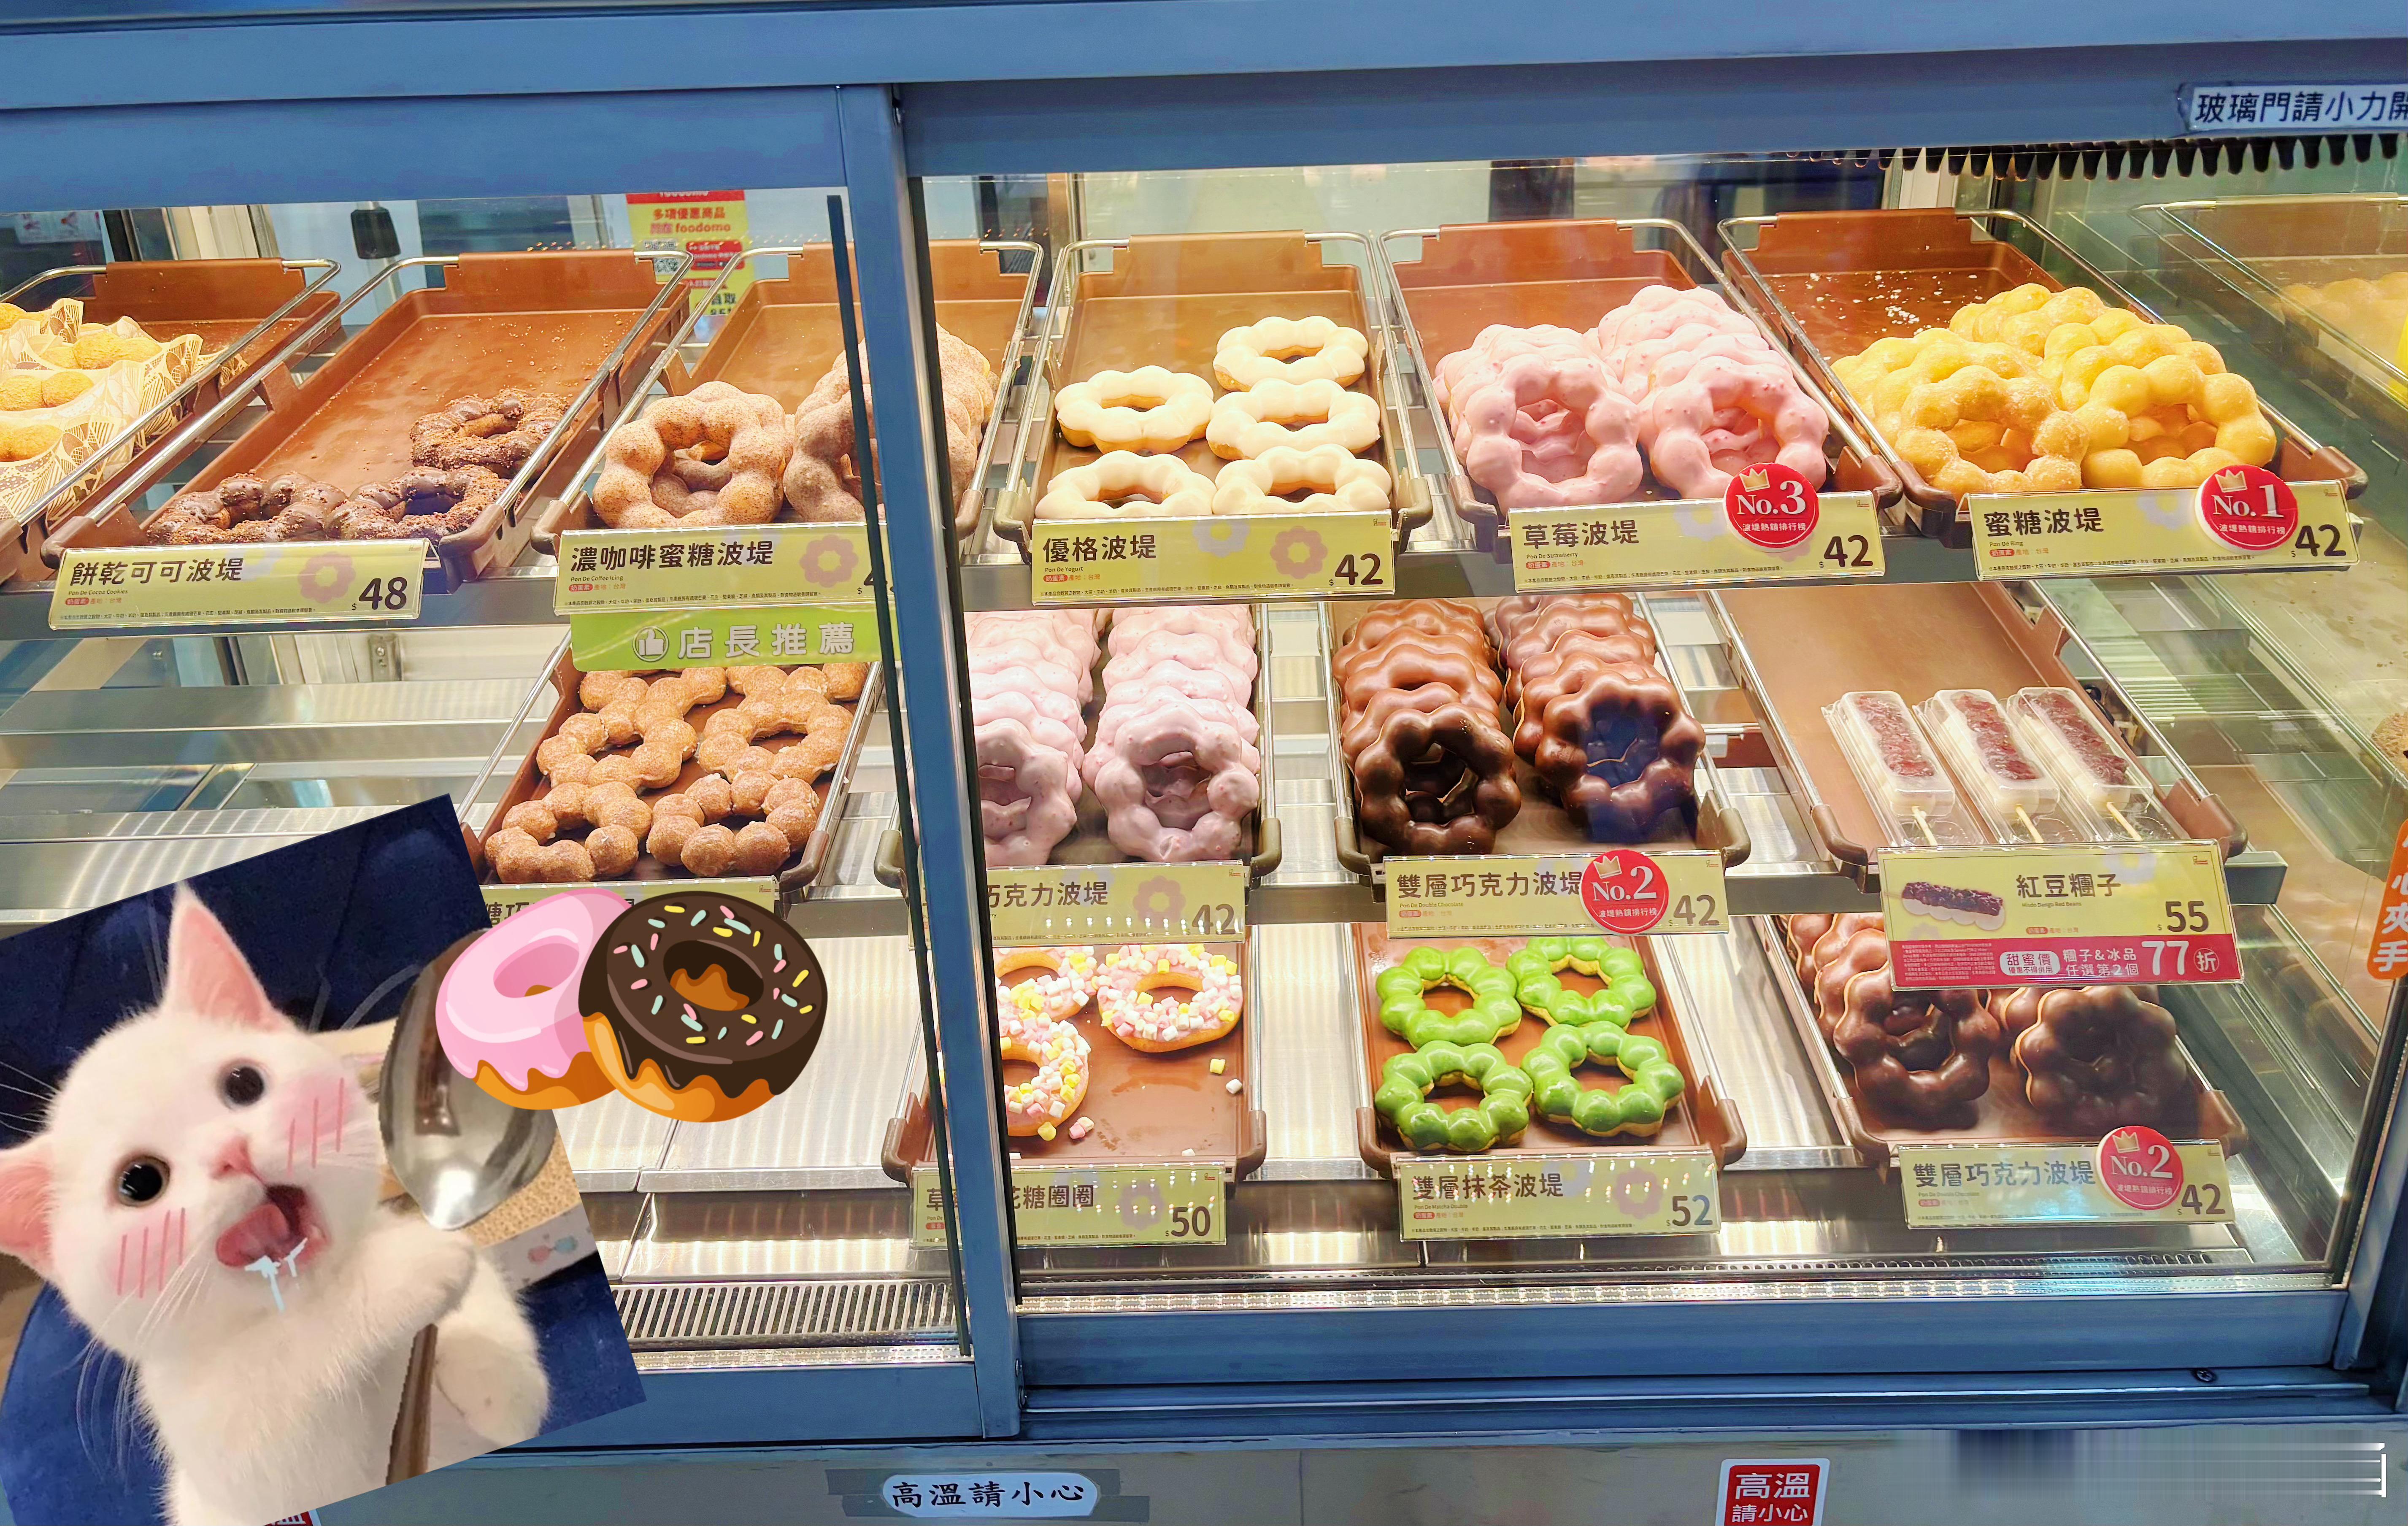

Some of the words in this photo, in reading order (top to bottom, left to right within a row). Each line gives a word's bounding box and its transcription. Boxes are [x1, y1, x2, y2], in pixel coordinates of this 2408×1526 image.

[2195, 91, 2408, 123] 玻璃門請小力開
[676, 222, 731, 232] foodomo
[1736, 481, 1806, 515] No.3
[2211, 484, 2284, 517] No.1
[1522, 520, 1639, 549] 草莓波堤
[1984, 508, 2104, 537] 蜜糖波堤
[571, 541, 773, 571] 濃咖啡蜜糖波堤
[1043, 535, 1156, 562] 優格波堤
[70, 558, 244, 586] 餅乾可可波堤
[678, 622, 854, 659] 店長推薦
[1397, 871, 1582, 899] 雙層巧克力波堤
[1590, 866, 1657, 901] No.2
[2016, 873, 2122, 898] 紅豆糰子
[2006, 953, 2051, 966] 甜蜜價
[2141, 940, 2189, 975] 77
[2196, 951, 2216, 972] 折
[1913, 1161, 2096, 1187] 雙層巧克力波堤
[2110, 1145, 2173, 1179] No.2
[1413, 1173, 1563, 1200] 雙層抹茶波堤
[892, 1481, 1084, 1507] 高溫請小心
[1735, 1472, 1810, 1499] 高溫
[1732, 1504, 1808, 1522] 請小心
